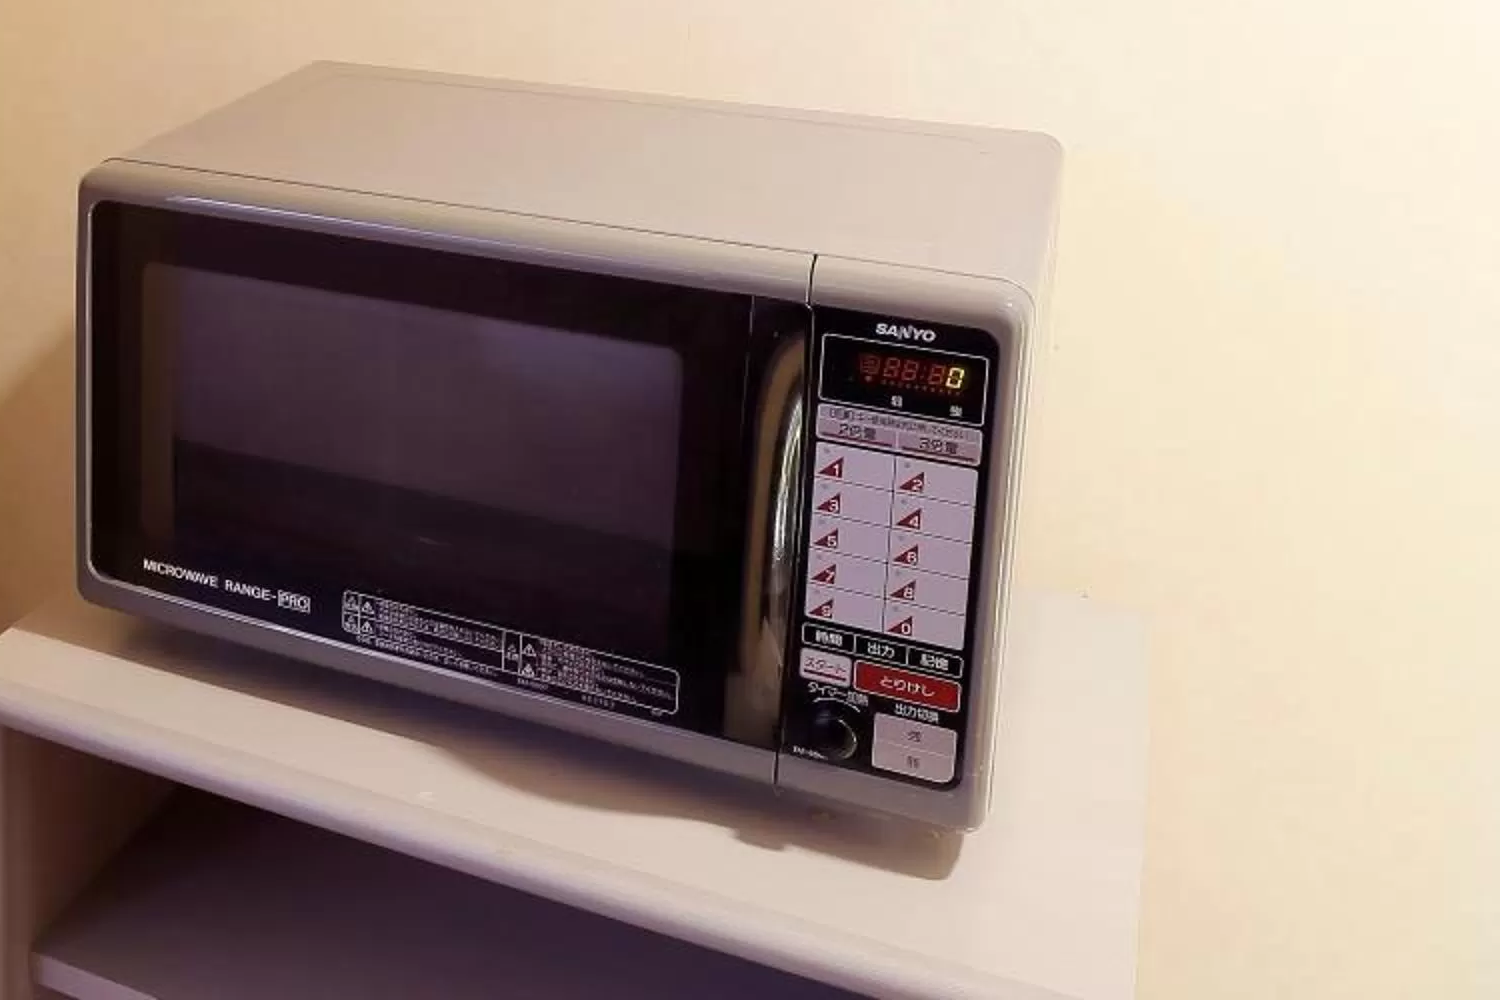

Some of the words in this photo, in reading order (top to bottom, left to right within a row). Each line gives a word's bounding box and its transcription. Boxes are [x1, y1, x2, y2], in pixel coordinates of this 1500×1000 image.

[875, 322, 937, 343] SANYO
[143, 558, 219, 589] MICROWAVE
[867, 641, 895, 659] 出力
[804, 656, 847, 674] スタート
[880, 675, 936, 697] とりけし
